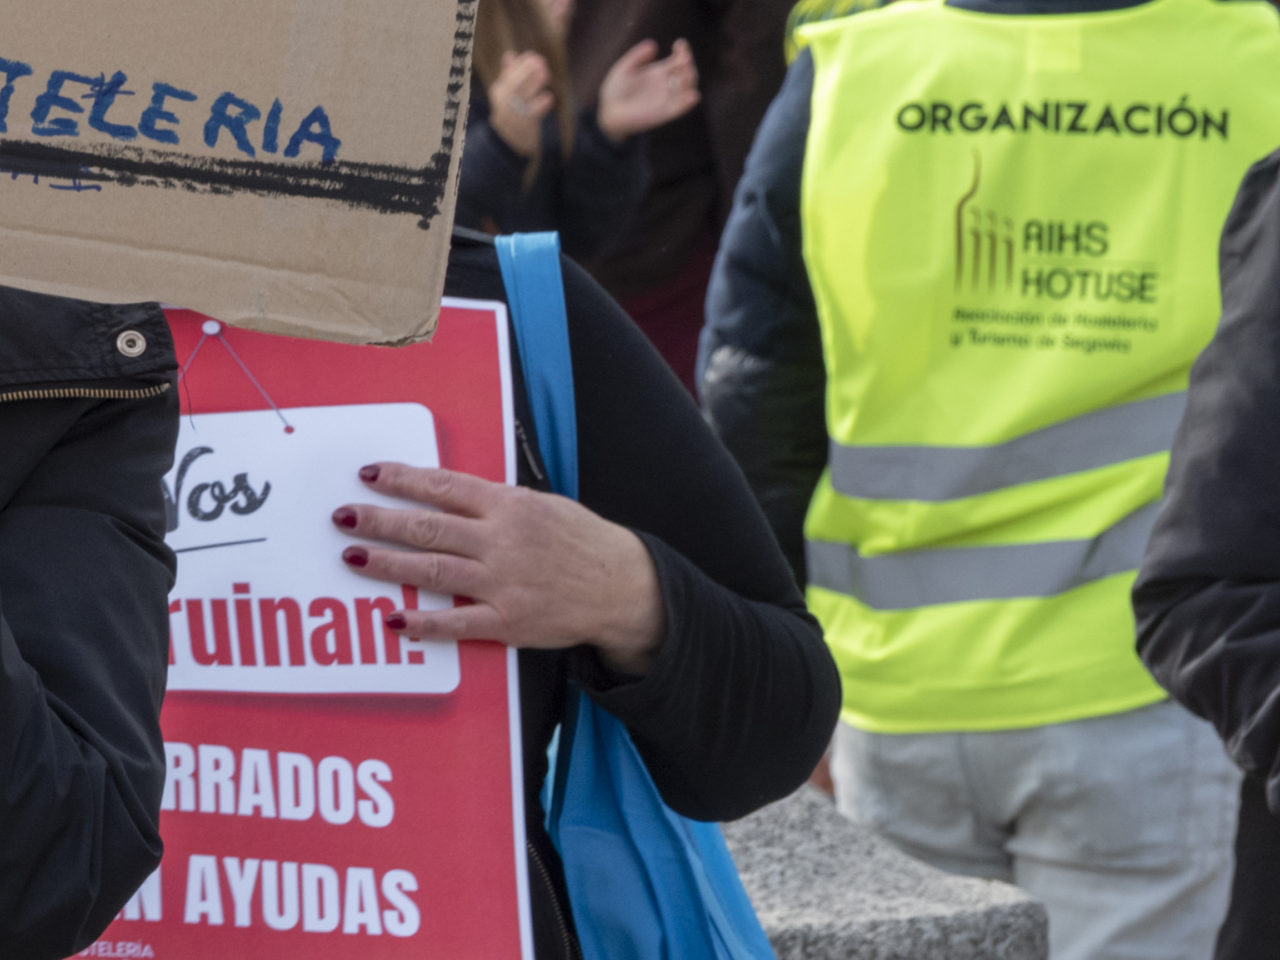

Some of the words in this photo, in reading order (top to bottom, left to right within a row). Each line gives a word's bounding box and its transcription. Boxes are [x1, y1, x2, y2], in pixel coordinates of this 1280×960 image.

[897, 94, 1230, 140] ORGANIZACIÓN
[1023, 219, 1110, 257] AIHS
[1022, 268, 1158, 304] HOTUSE
[160, 741, 396, 828] RRADOS
[183, 854, 420, 938] AYUDAS
